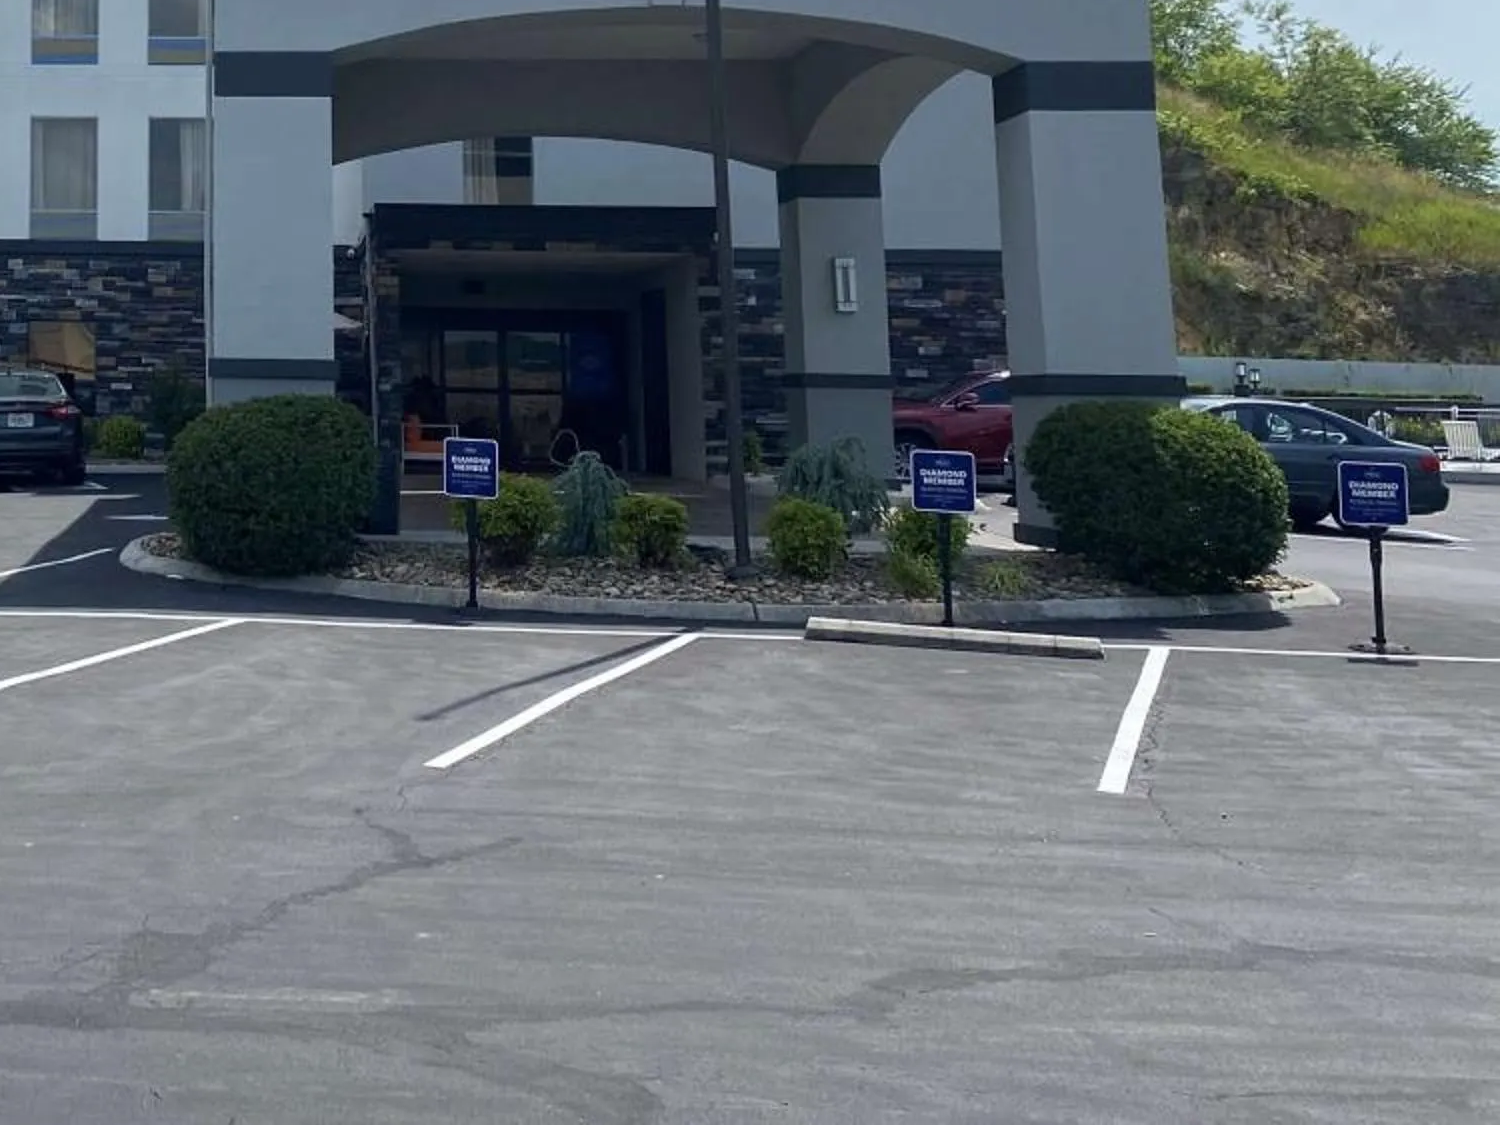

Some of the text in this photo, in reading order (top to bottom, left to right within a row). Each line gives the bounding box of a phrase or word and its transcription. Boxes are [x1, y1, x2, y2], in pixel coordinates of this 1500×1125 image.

[919, 468, 968, 479] DIAMOND
[923, 476, 965, 486] MEMBER
[1348, 480, 1399, 491] DIAMOND
[1351, 488, 1397, 499] MEMBER
